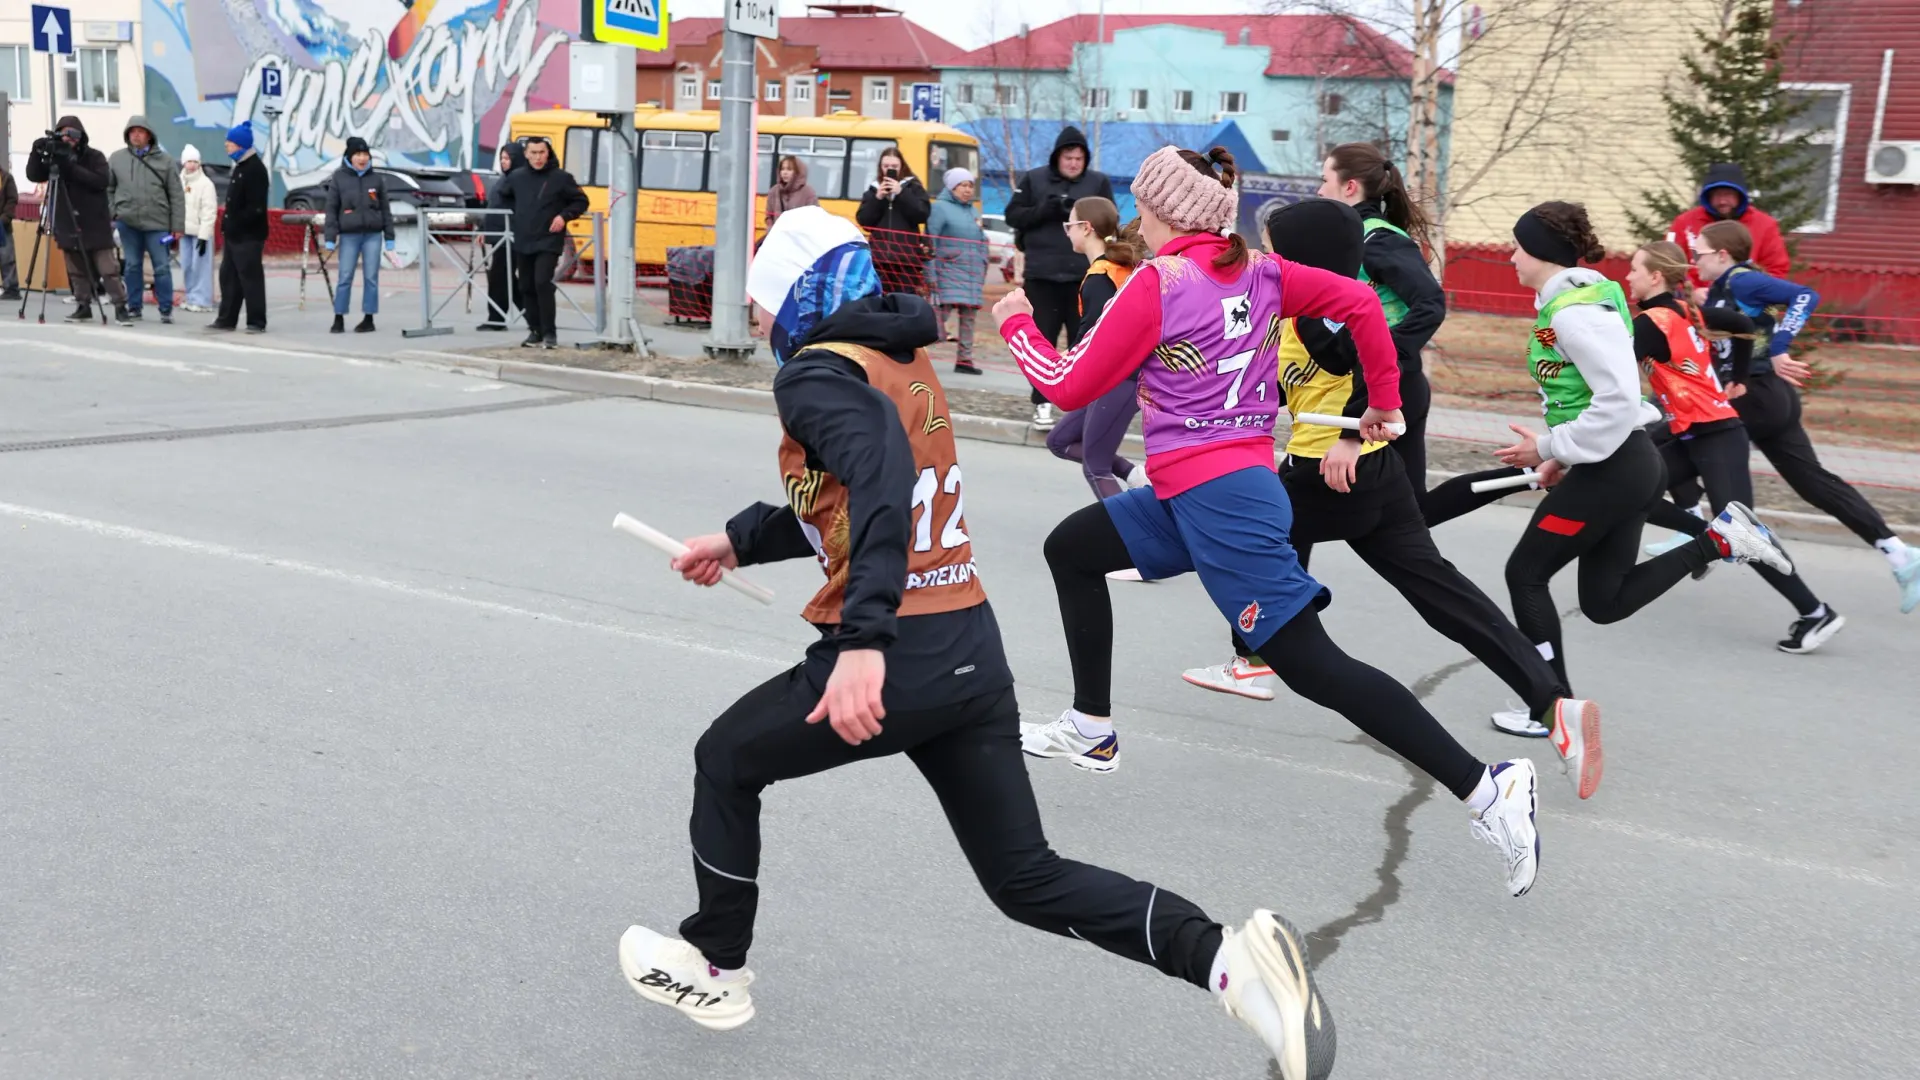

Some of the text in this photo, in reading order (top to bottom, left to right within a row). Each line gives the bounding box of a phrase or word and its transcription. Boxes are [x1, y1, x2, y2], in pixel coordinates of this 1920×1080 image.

[651, 196, 698, 216] ДЕТИ
[1216, 348, 1257, 411] 7
[1256, 381, 1266, 402] 1
[911, 463, 970, 552] 12
